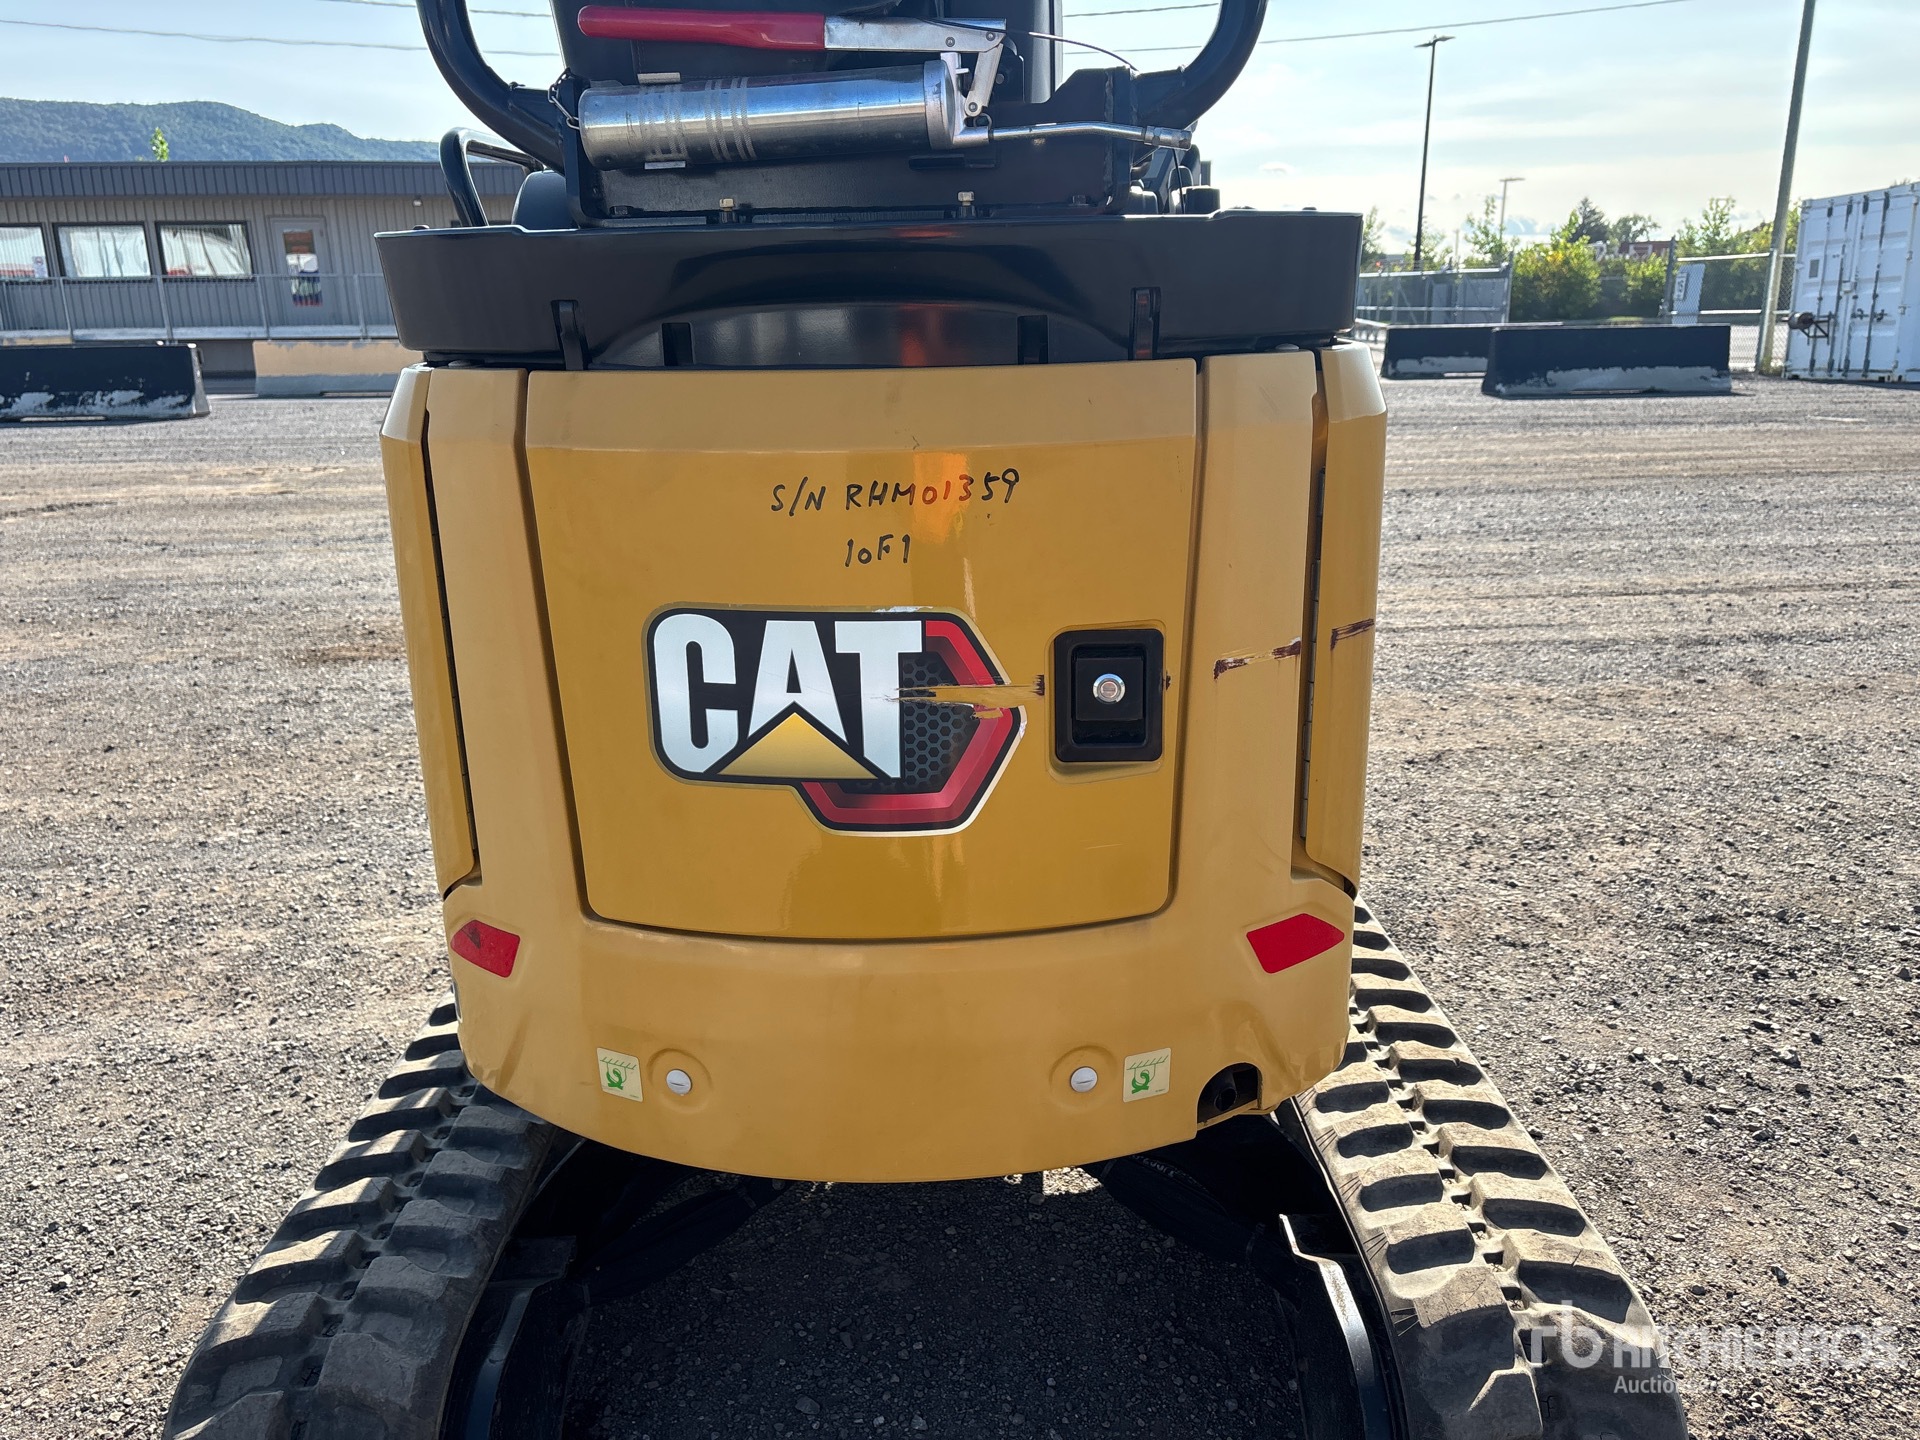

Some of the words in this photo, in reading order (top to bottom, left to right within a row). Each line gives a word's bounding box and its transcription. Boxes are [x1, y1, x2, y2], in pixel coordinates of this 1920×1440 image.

[770, 476, 826, 516] S/N
[846, 467, 1020, 510] RHM01359
[653, 612, 923, 780] CAT
